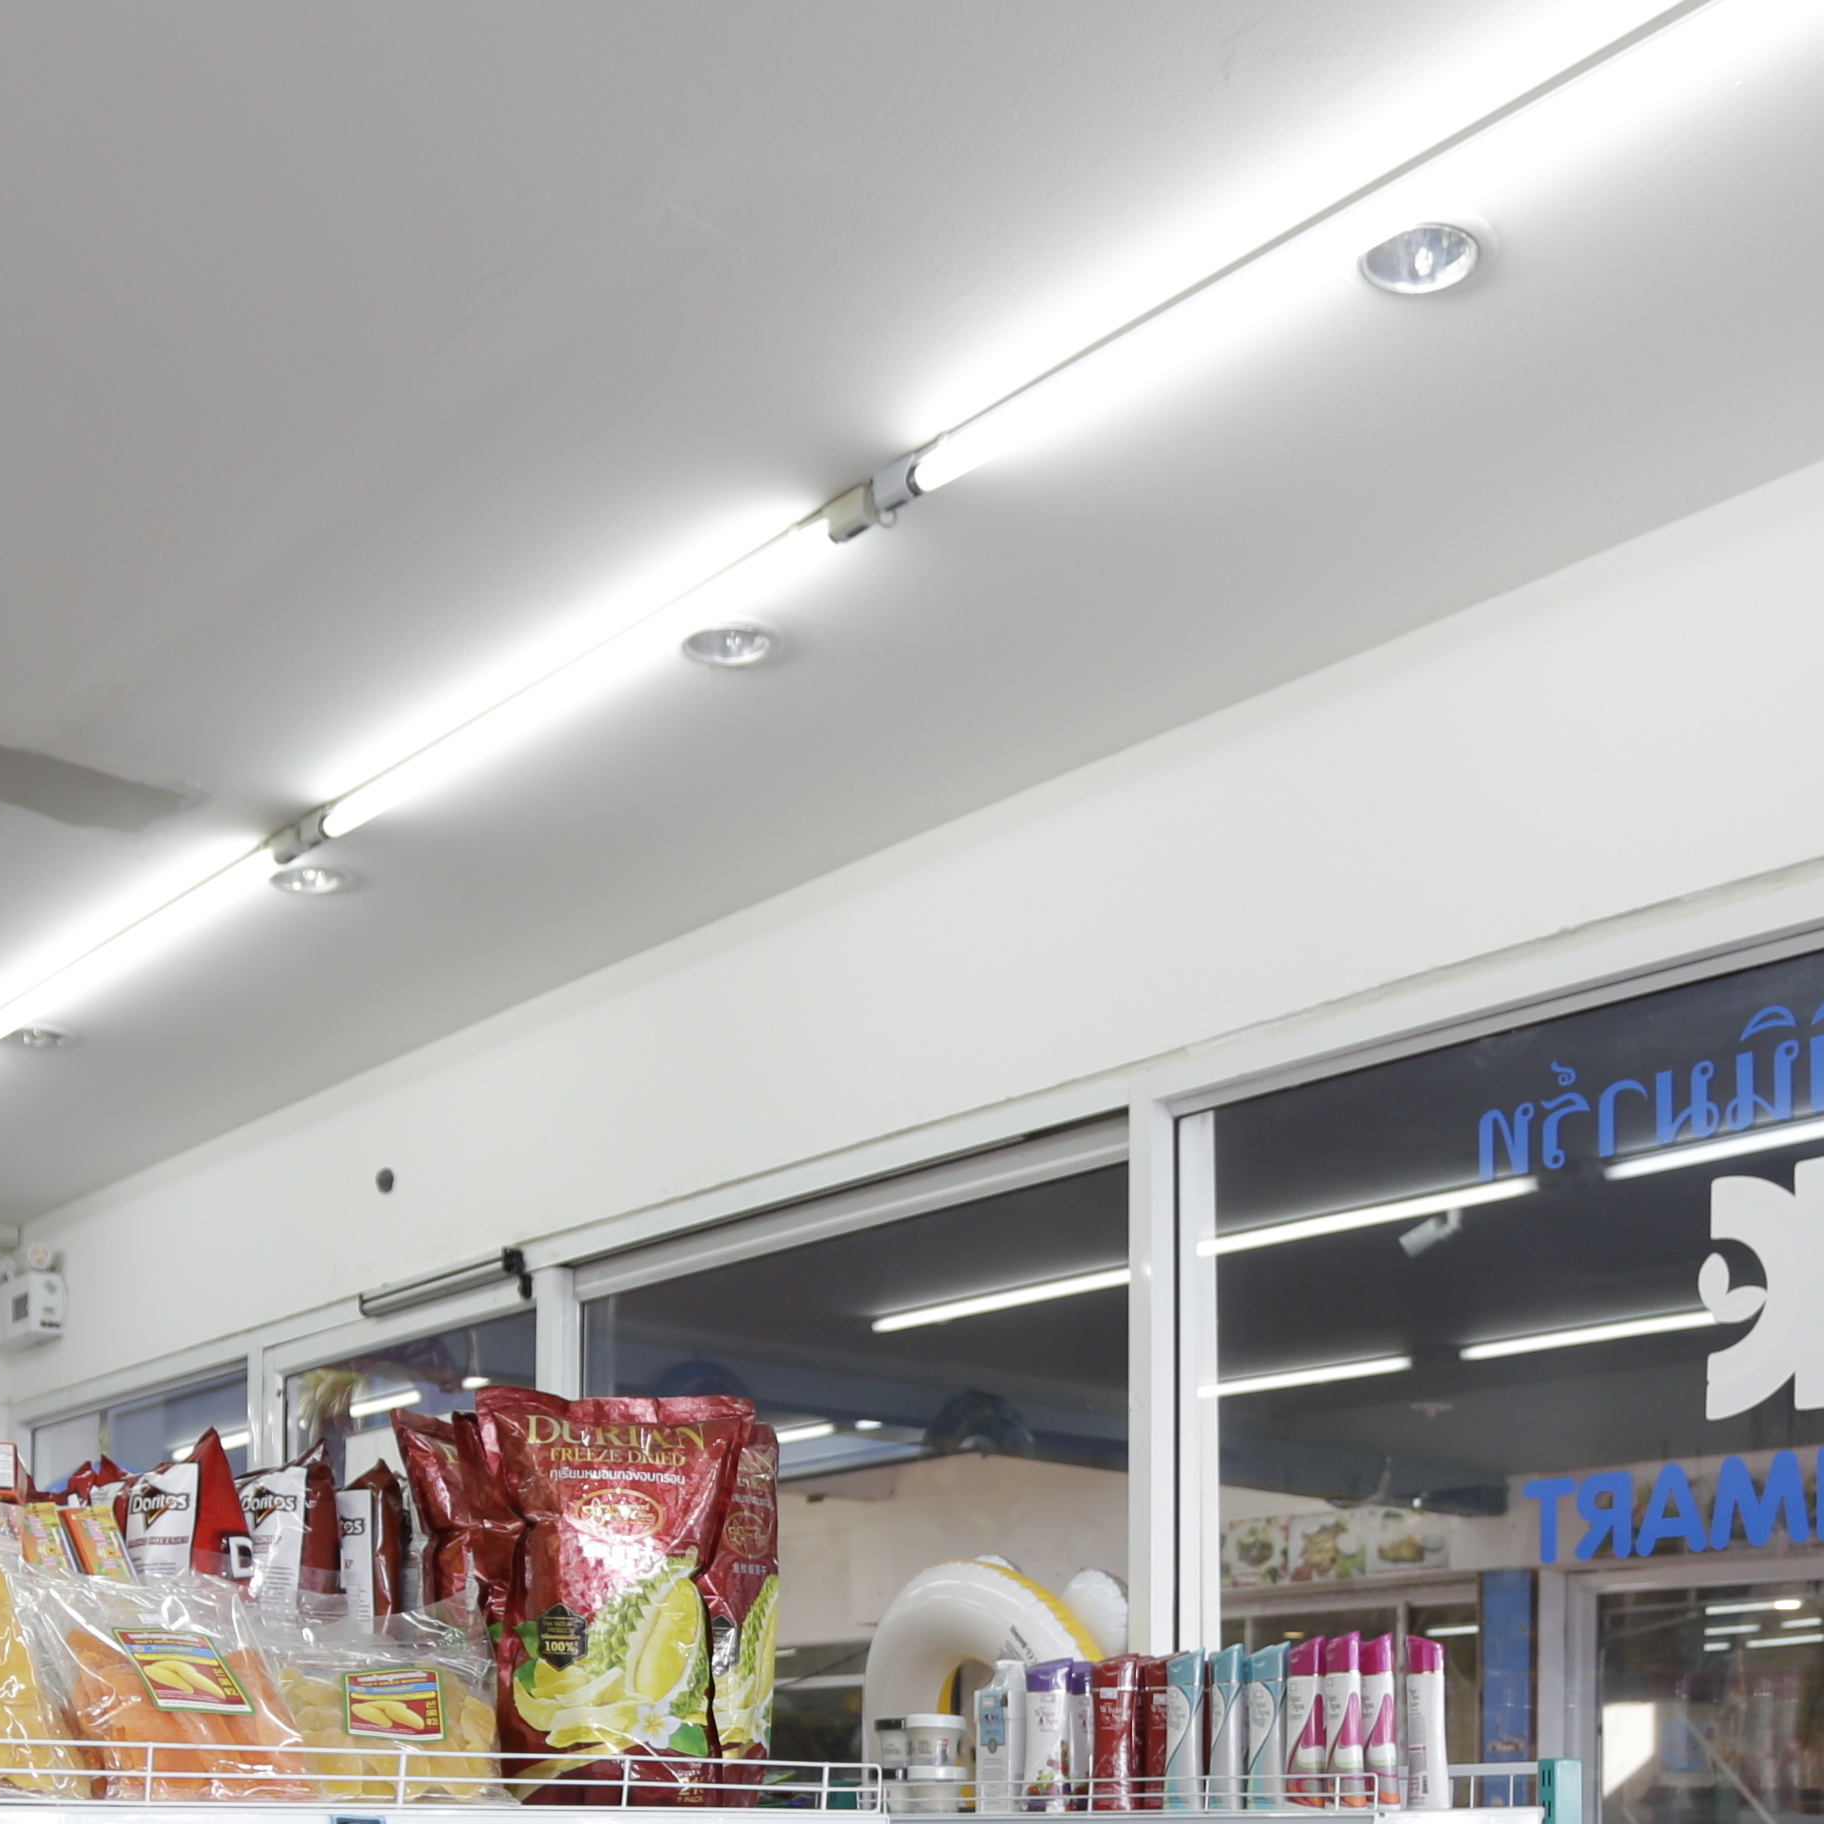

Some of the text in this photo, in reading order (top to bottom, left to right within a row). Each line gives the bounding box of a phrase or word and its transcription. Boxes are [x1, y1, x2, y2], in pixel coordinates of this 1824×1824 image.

[525, 1414, 704, 1451] DURIAN
[130, 1493, 190, 1513] Doritos
[240, 1493, 297, 1513] Doritos
